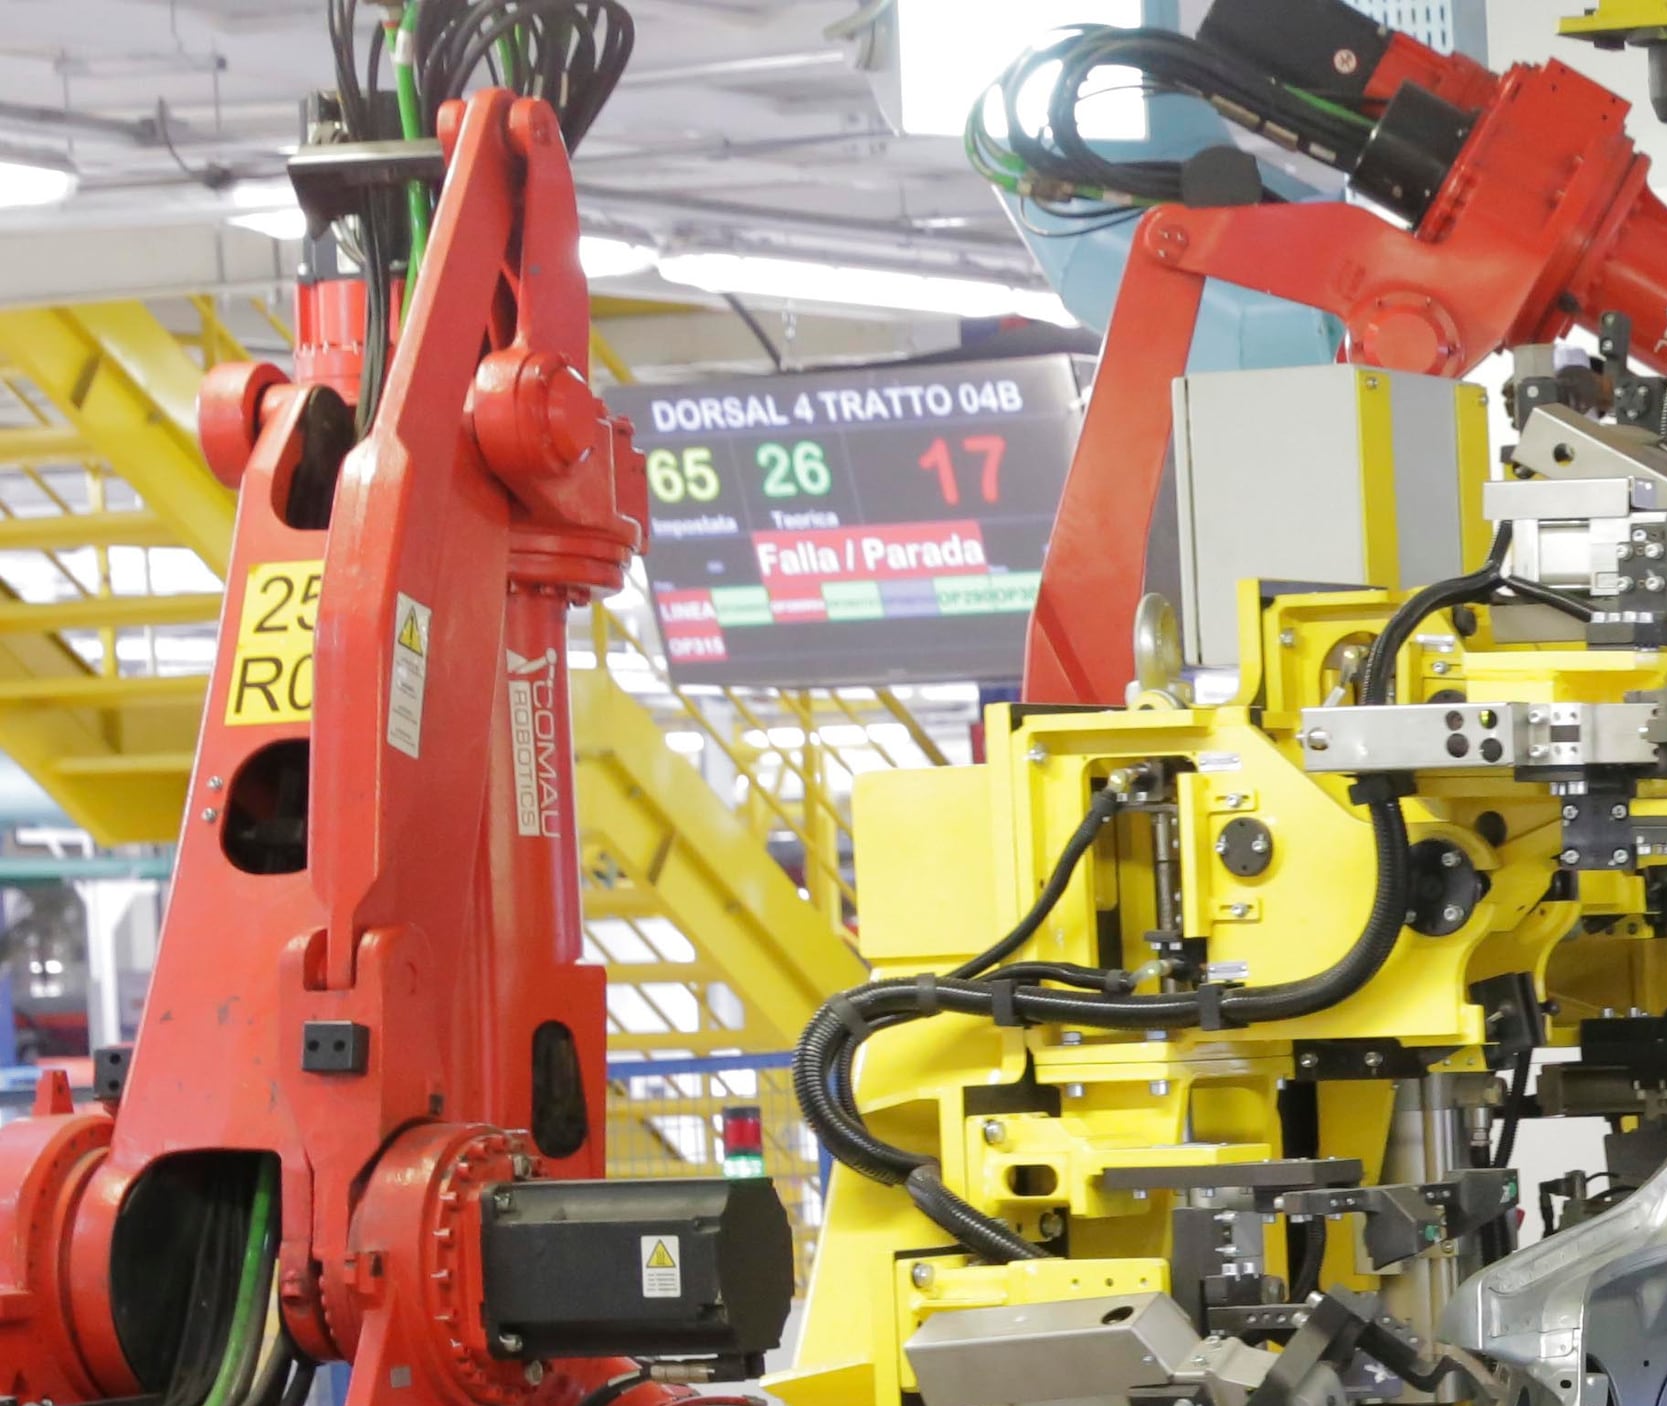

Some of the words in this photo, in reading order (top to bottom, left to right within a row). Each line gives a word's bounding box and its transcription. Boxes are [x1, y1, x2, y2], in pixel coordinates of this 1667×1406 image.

[652, 394, 789, 432] DORSAL
[793, 392, 815, 422] 4
[816, 384, 953, 422] TRATTO
[956, 381, 1024, 413] 04B
[646, 446, 720, 503] 65
[756, 440, 831, 499] 26
[919, 435, 1006, 505] 17
[757, 541, 840, 577] Falla
[861, 533, 986, 571] Parada
[513, 688, 536, 827] ROBOTICS
[532, 677, 562, 839] COMAU
